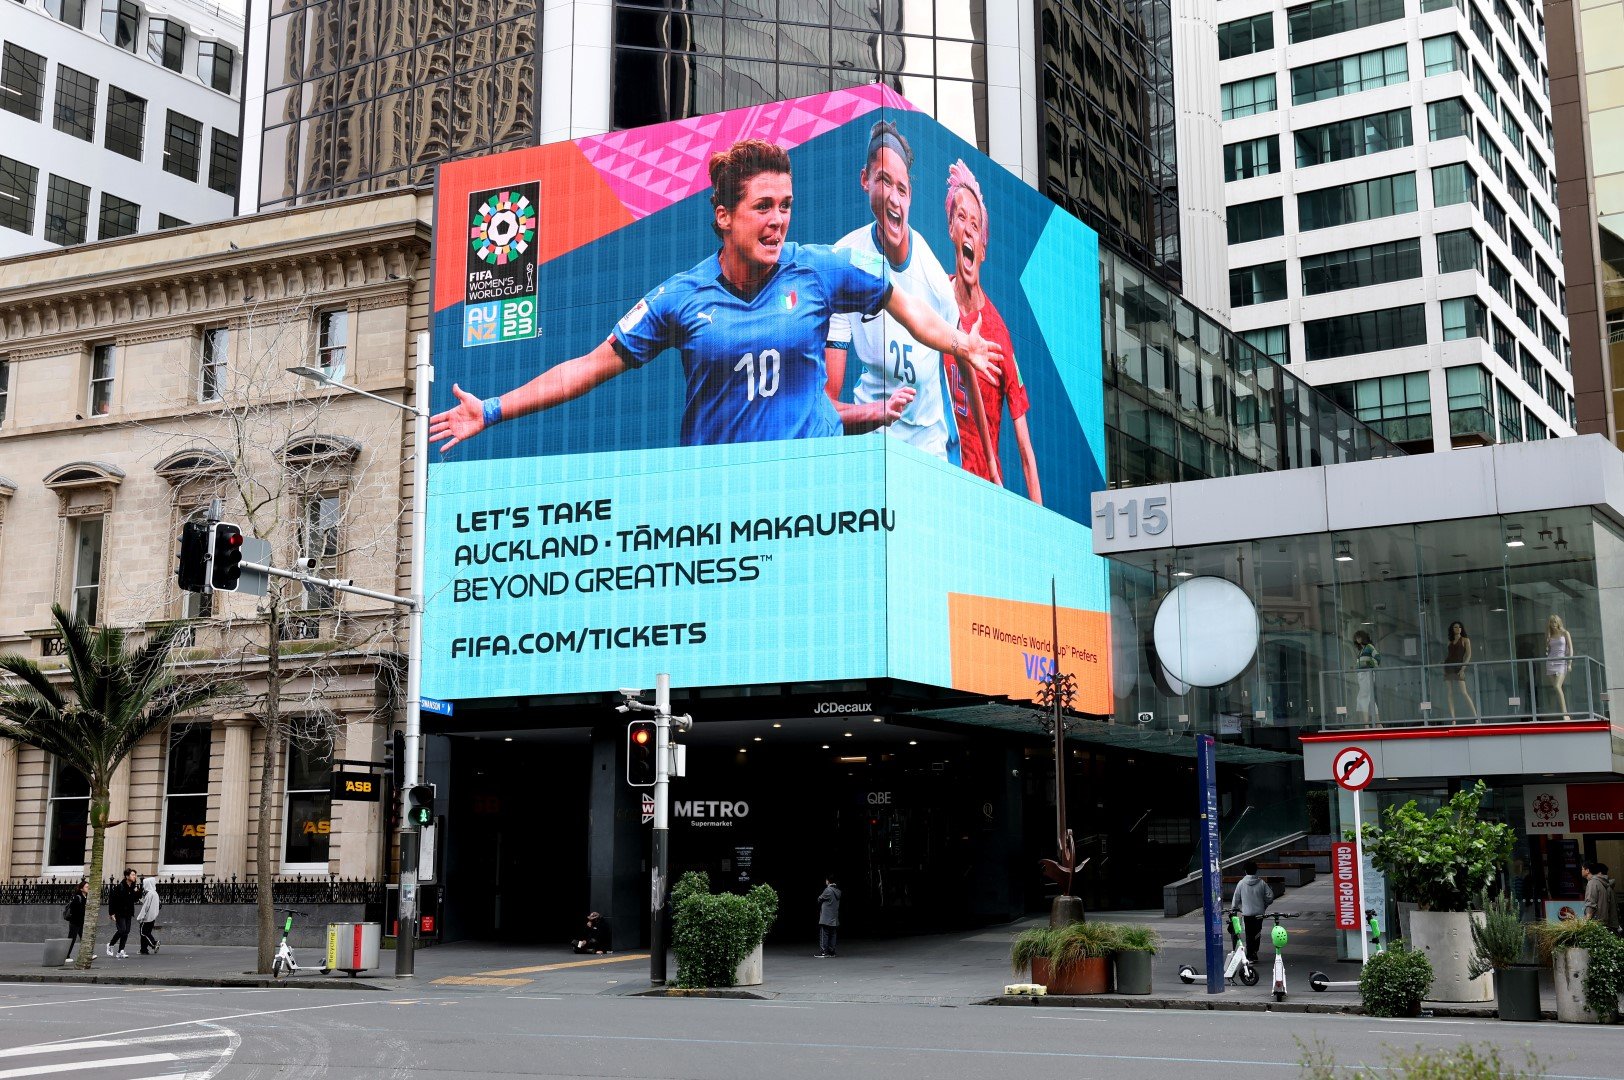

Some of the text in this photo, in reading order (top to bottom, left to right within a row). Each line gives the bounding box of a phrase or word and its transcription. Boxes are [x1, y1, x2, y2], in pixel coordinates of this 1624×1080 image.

[469, 270, 493, 282] FIFA
[469, 277, 514, 292] WOMEN'S
[469, 284, 523, 300] WORLD CUP
[468, 305, 498, 325] AU
[503, 301, 534, 318] 20
[467, 323, 496, 341] NZ
[503, 318, 533, 337] 23
[889, 340, 917, 385] 25
[734, 349, 780, 401] 10
[456, 499, 612, 533] LET'S TAKE
[1096, 497, 1169, 540] 115
[454, 508, 896, 566] AUCKLAND TĀMAKI MAKAURAU
[453, 571, 569, 603] BEYOND
[451, 622, 707, 659] FIFA.COM/TICKETS
[971, 622, 991, 639] FIFA
[992, 627, 1028, 647] Women's
[1029, 636, 1051, 652] World
[1071, 647, 1098, 664] Prefers
[813, 702, 873, 714] JCDecaux
[345, 780, 372, 793] ASB
[867, 791, 892, 804] QBE
[674, 800, 750, 818] METRO
[1572, 812, 1613, 821] FOREIGN
[690, 820, 733, 828] Supermarket
[1337, 846, 1355, 926] GRAND OPENING
